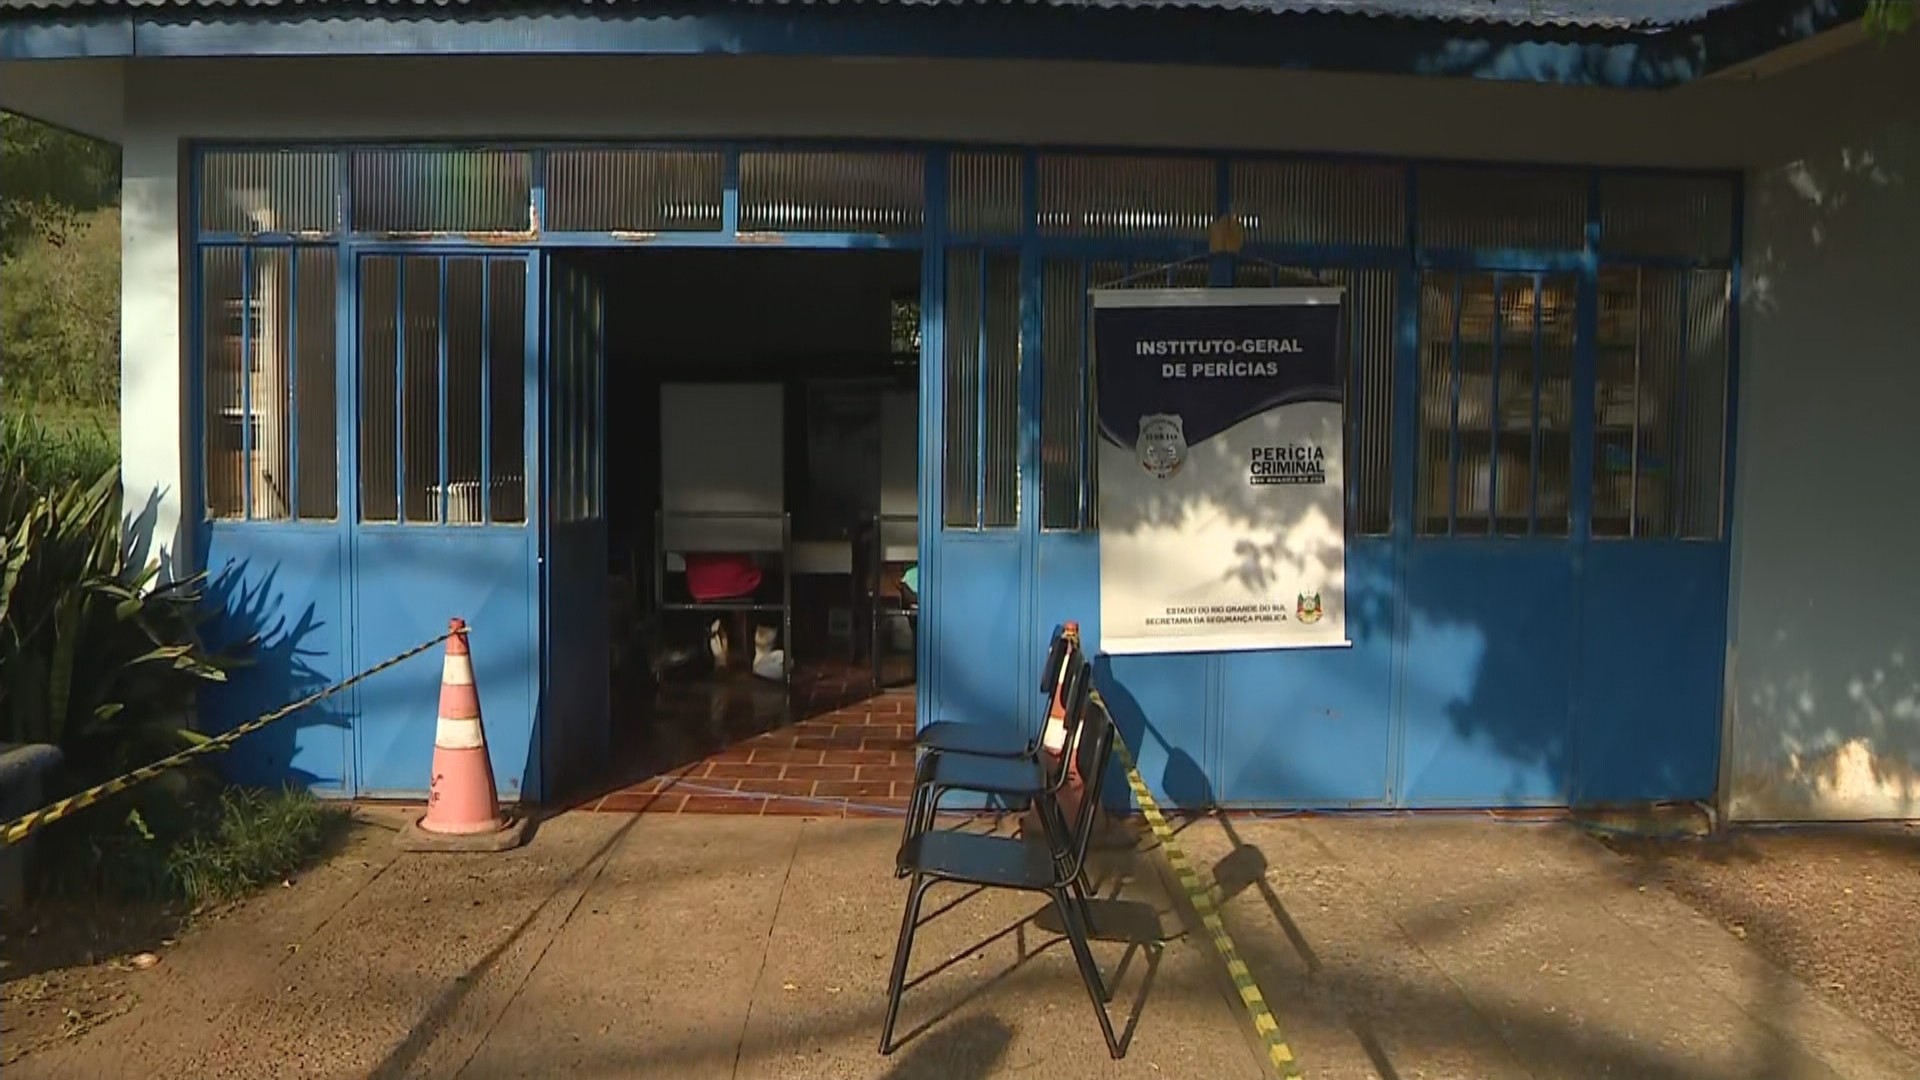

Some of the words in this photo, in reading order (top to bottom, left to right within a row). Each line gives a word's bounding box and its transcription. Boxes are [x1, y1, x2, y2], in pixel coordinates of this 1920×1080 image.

[1136, 339, 1303, 355] INSTITUTO-GERAL
[1162, 363, 1186, 377] DE
[1193, 360, 1278, 377] PERÍCIAS
[1251, 443, 1324, 460] PERÍCIA
[1250, 460, 1325, 475] CRIMINAL
[1166, 606, 1197, 615] ESTADO
[1145, 617, 1193, 625] SECRETARIA
